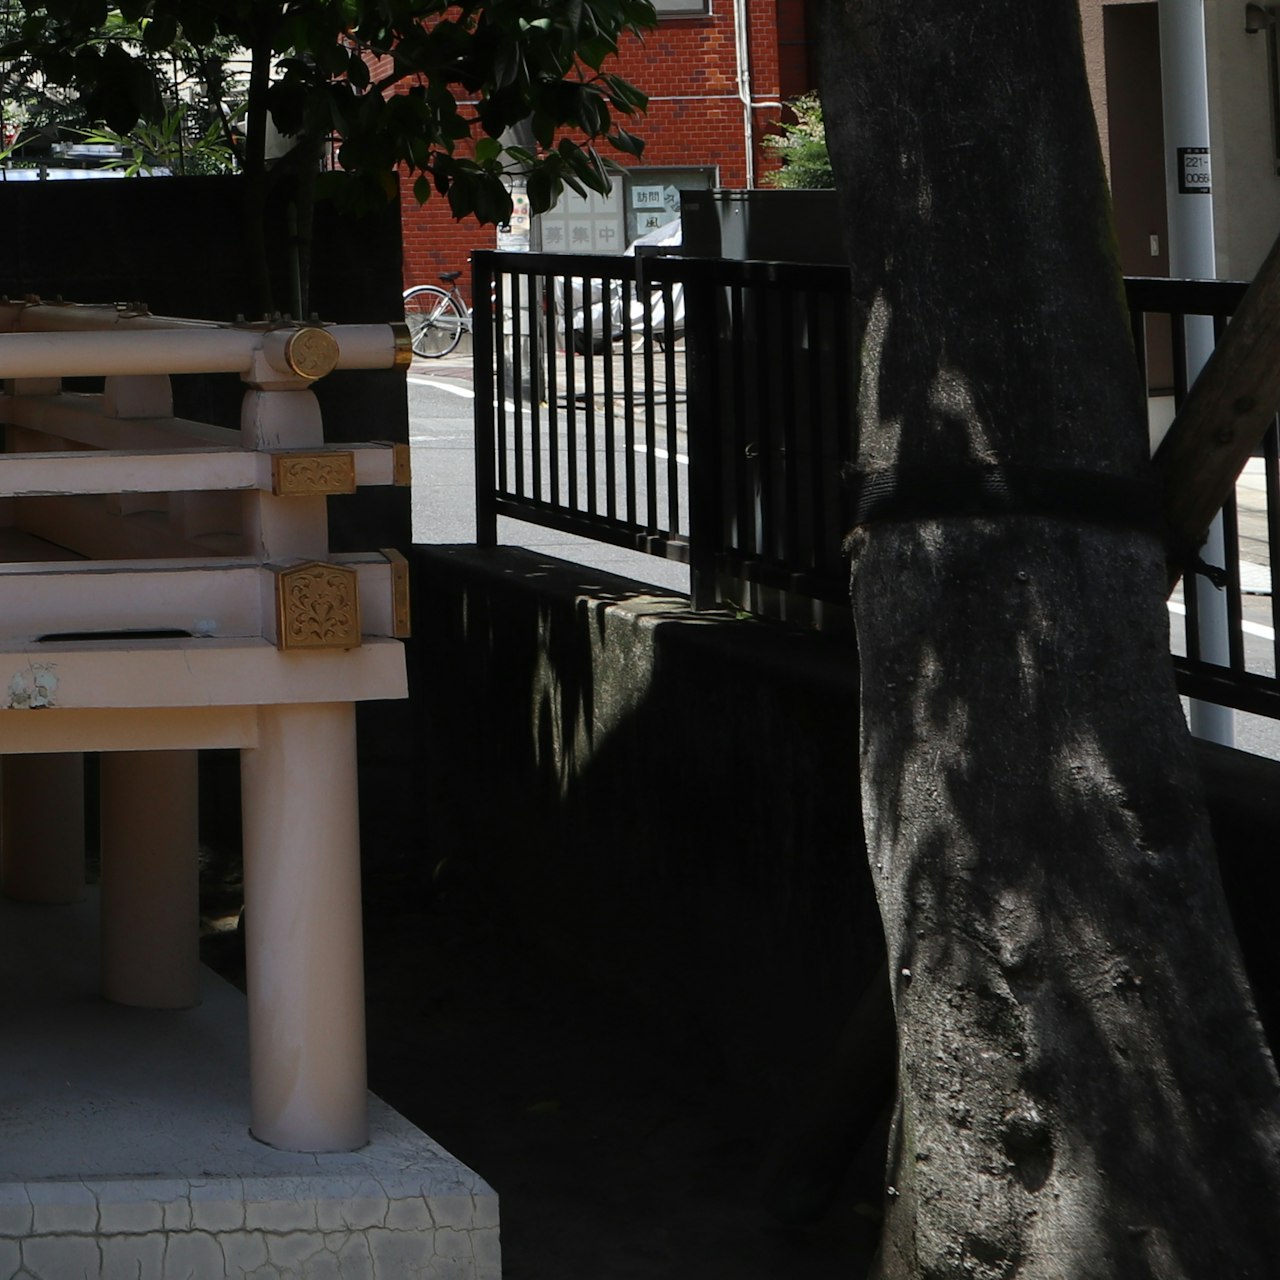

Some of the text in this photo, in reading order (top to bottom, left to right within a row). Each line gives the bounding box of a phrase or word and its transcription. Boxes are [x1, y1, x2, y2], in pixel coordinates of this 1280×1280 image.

[637, 191, 659, 203] 訪問
[546, 225, 615, 244] 募集中
